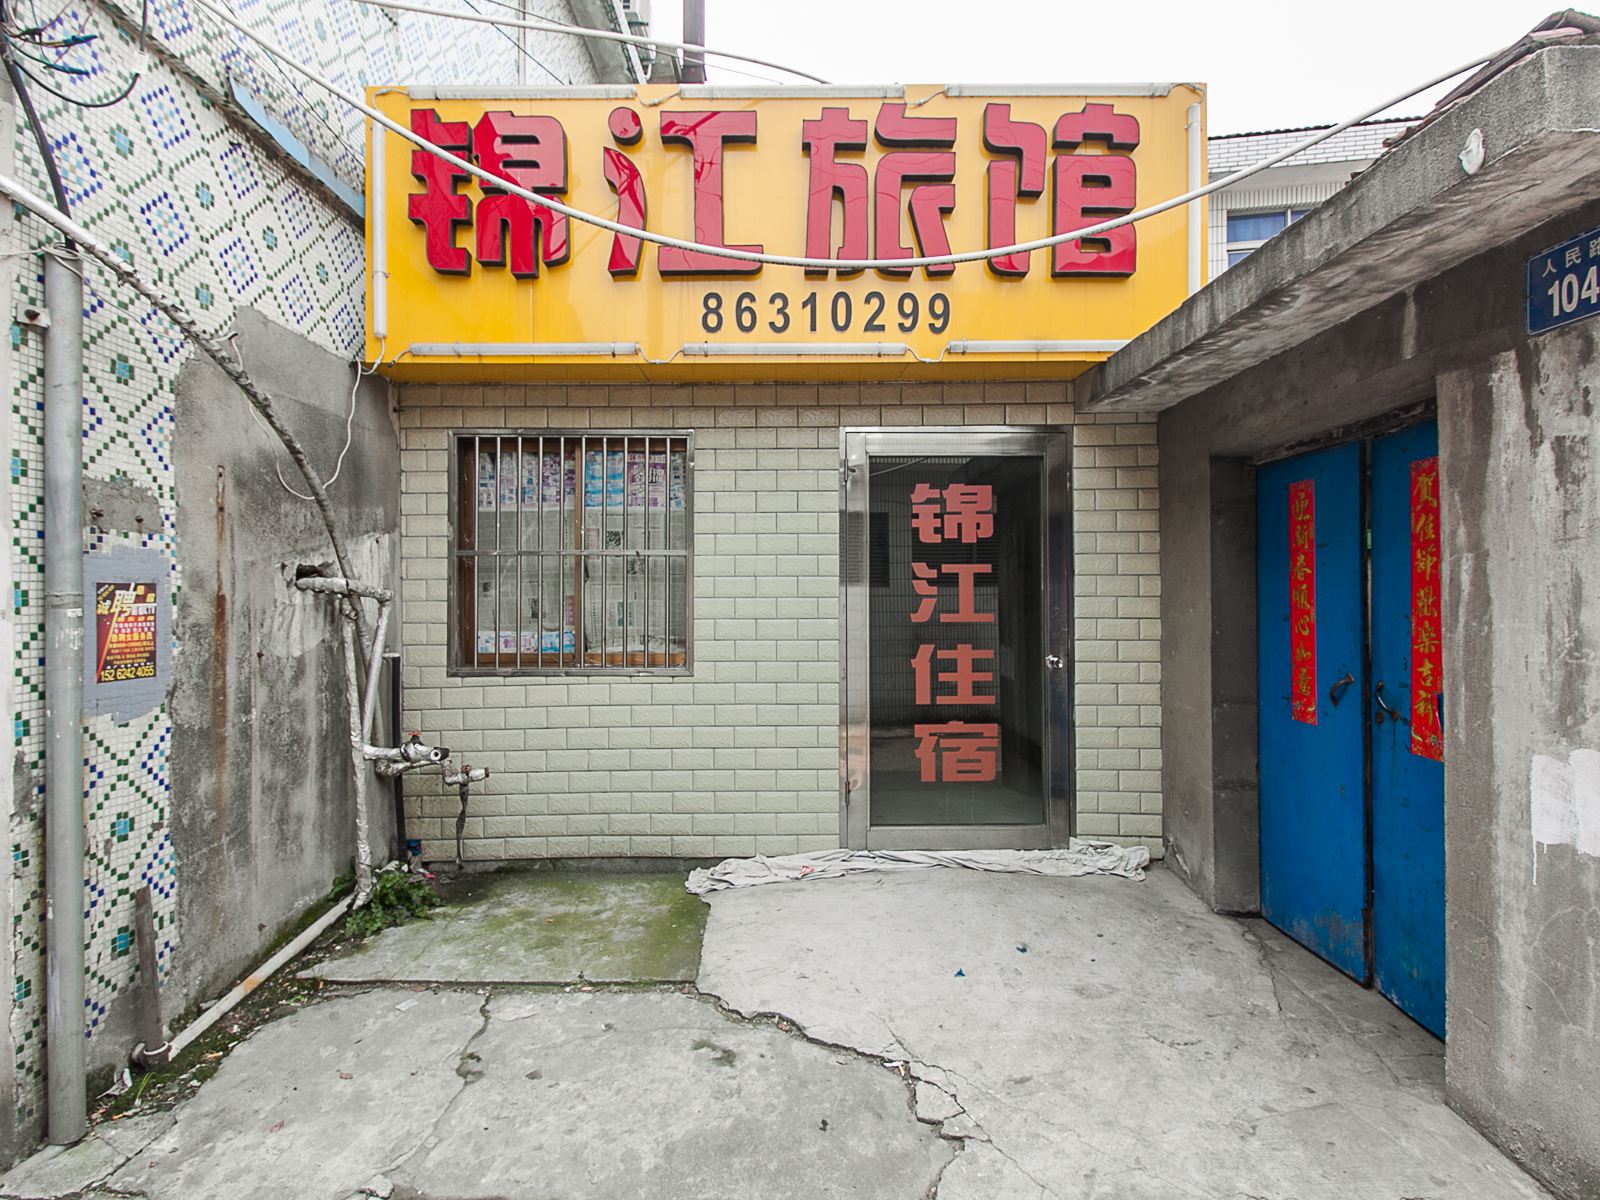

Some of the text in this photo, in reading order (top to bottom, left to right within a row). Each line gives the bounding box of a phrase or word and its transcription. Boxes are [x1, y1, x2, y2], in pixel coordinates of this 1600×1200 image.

[408, 102, 1140, 278] 锦江旅馆
[701, 291, 951, 334] 86310299
[1548, 265, 1600, 317] 104
[910, 483, 999, 782] 锦江住宿
[102, 670, 115, 681] 152
